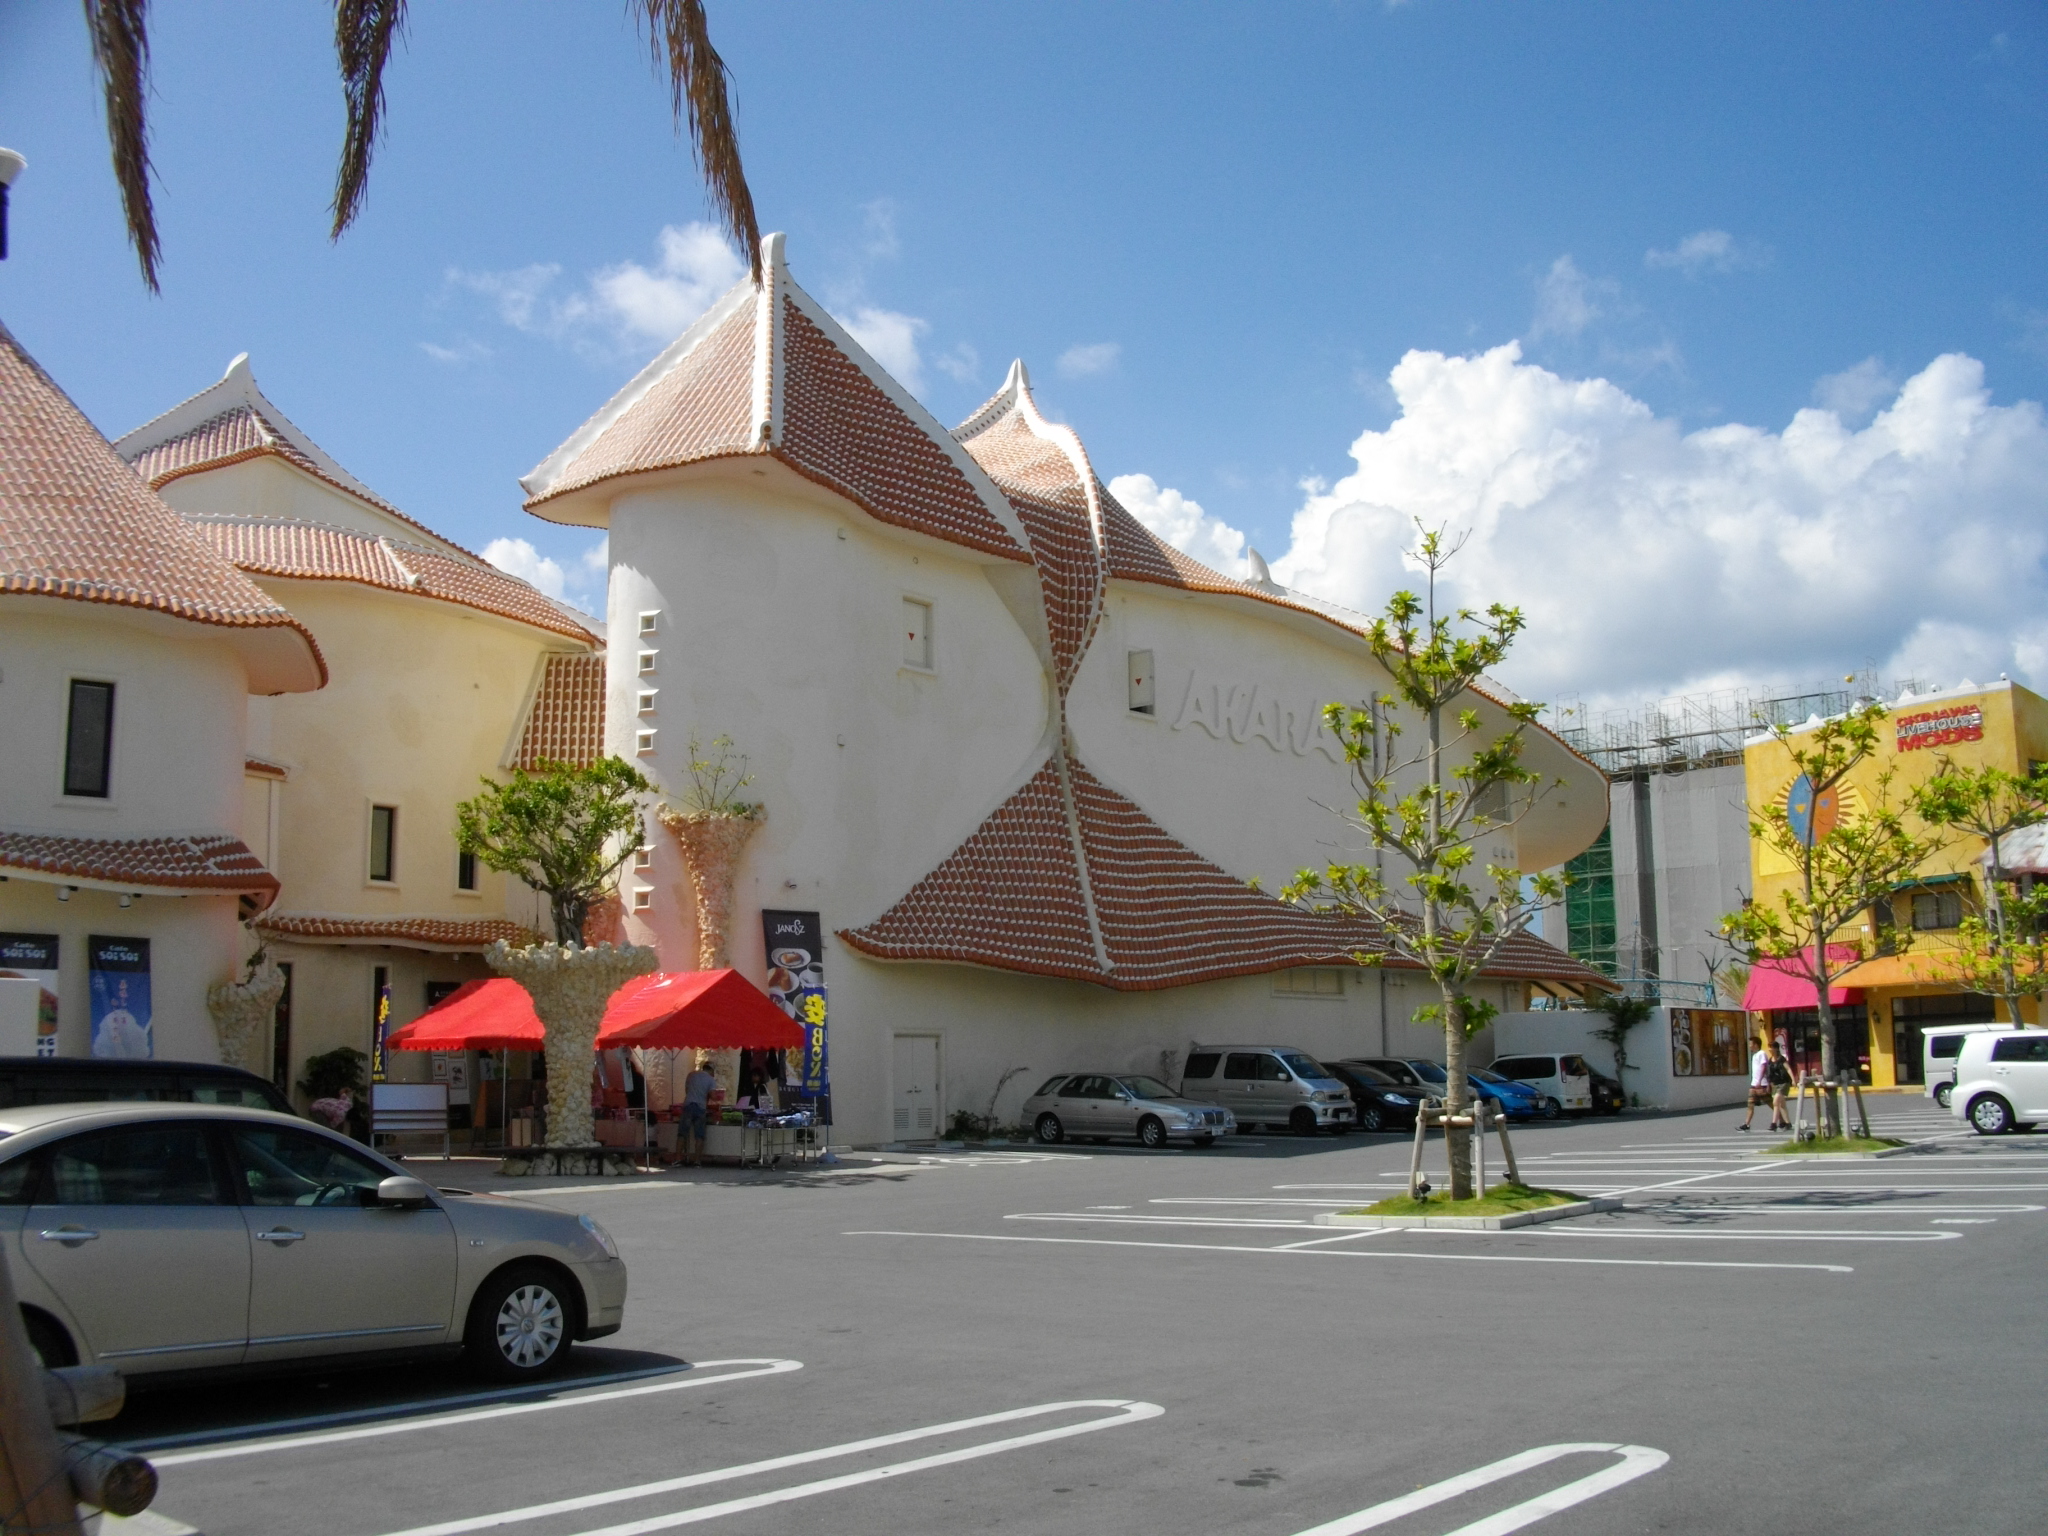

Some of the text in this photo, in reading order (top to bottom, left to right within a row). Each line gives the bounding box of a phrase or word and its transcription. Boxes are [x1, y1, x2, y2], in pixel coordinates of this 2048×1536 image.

[1171, 669, 1338, 765] AKARA
[1896, 704, 1981, 727] OKINAWA
[1896, 712, 1983, 738] LIVEHOUSE
[1897, 725, 1984, 753] MODS
